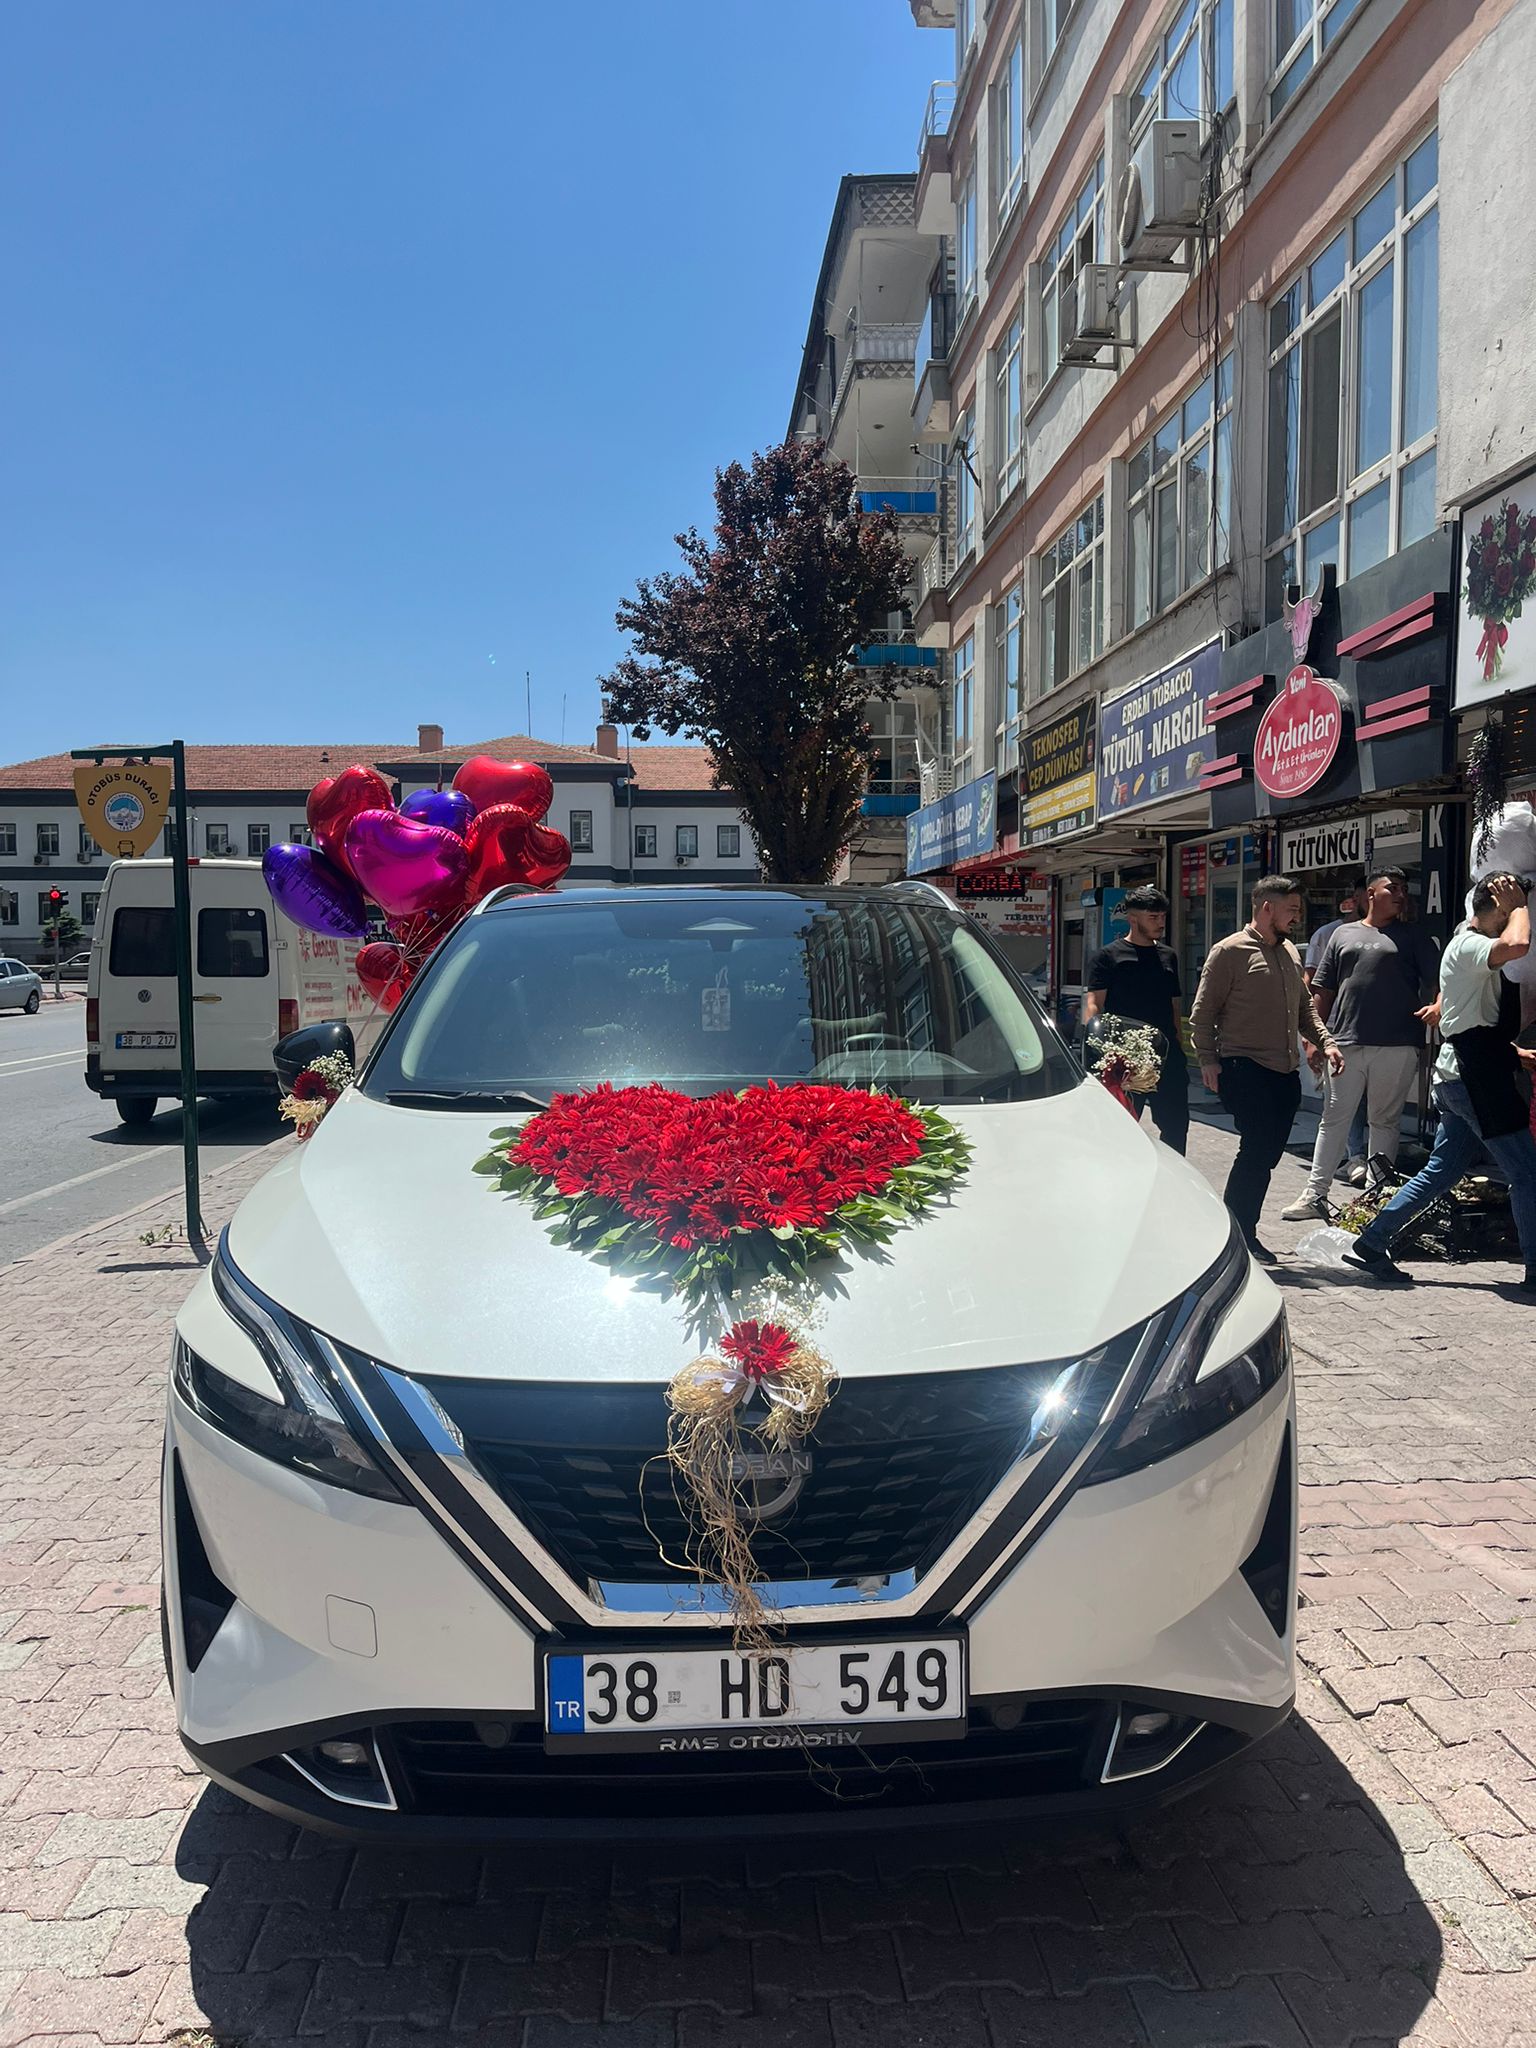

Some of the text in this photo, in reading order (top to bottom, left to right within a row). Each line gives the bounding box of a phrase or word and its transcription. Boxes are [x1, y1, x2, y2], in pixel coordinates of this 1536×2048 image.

[1122, 668, 1193, 726] ERDEM TOBACCO
[1290, 671, 1307, 695] Yeni
[1032, 716, 1079, 761] TEKNOSFER
[1103, 727, 1144, 778] TÜTÜN
[1261, 709, 1335, 775] Aydınlar
[87, 773, 160, 806] OTOBÜS DURAĞI
[1029, 745, 1084, 791] CEP DÜNYASI
[1287, 821, 1360, 869] TÜTÜNCÜ
[122, 1035, 133, 1045] 38
[158, 1035, 174, 1045] 217
[587, 1648, 948, 1724] 38 HD 549
[555, 1701, 580, 1718] TR
[659, 1729, 863, 1751] RMS OTOMOTİV
